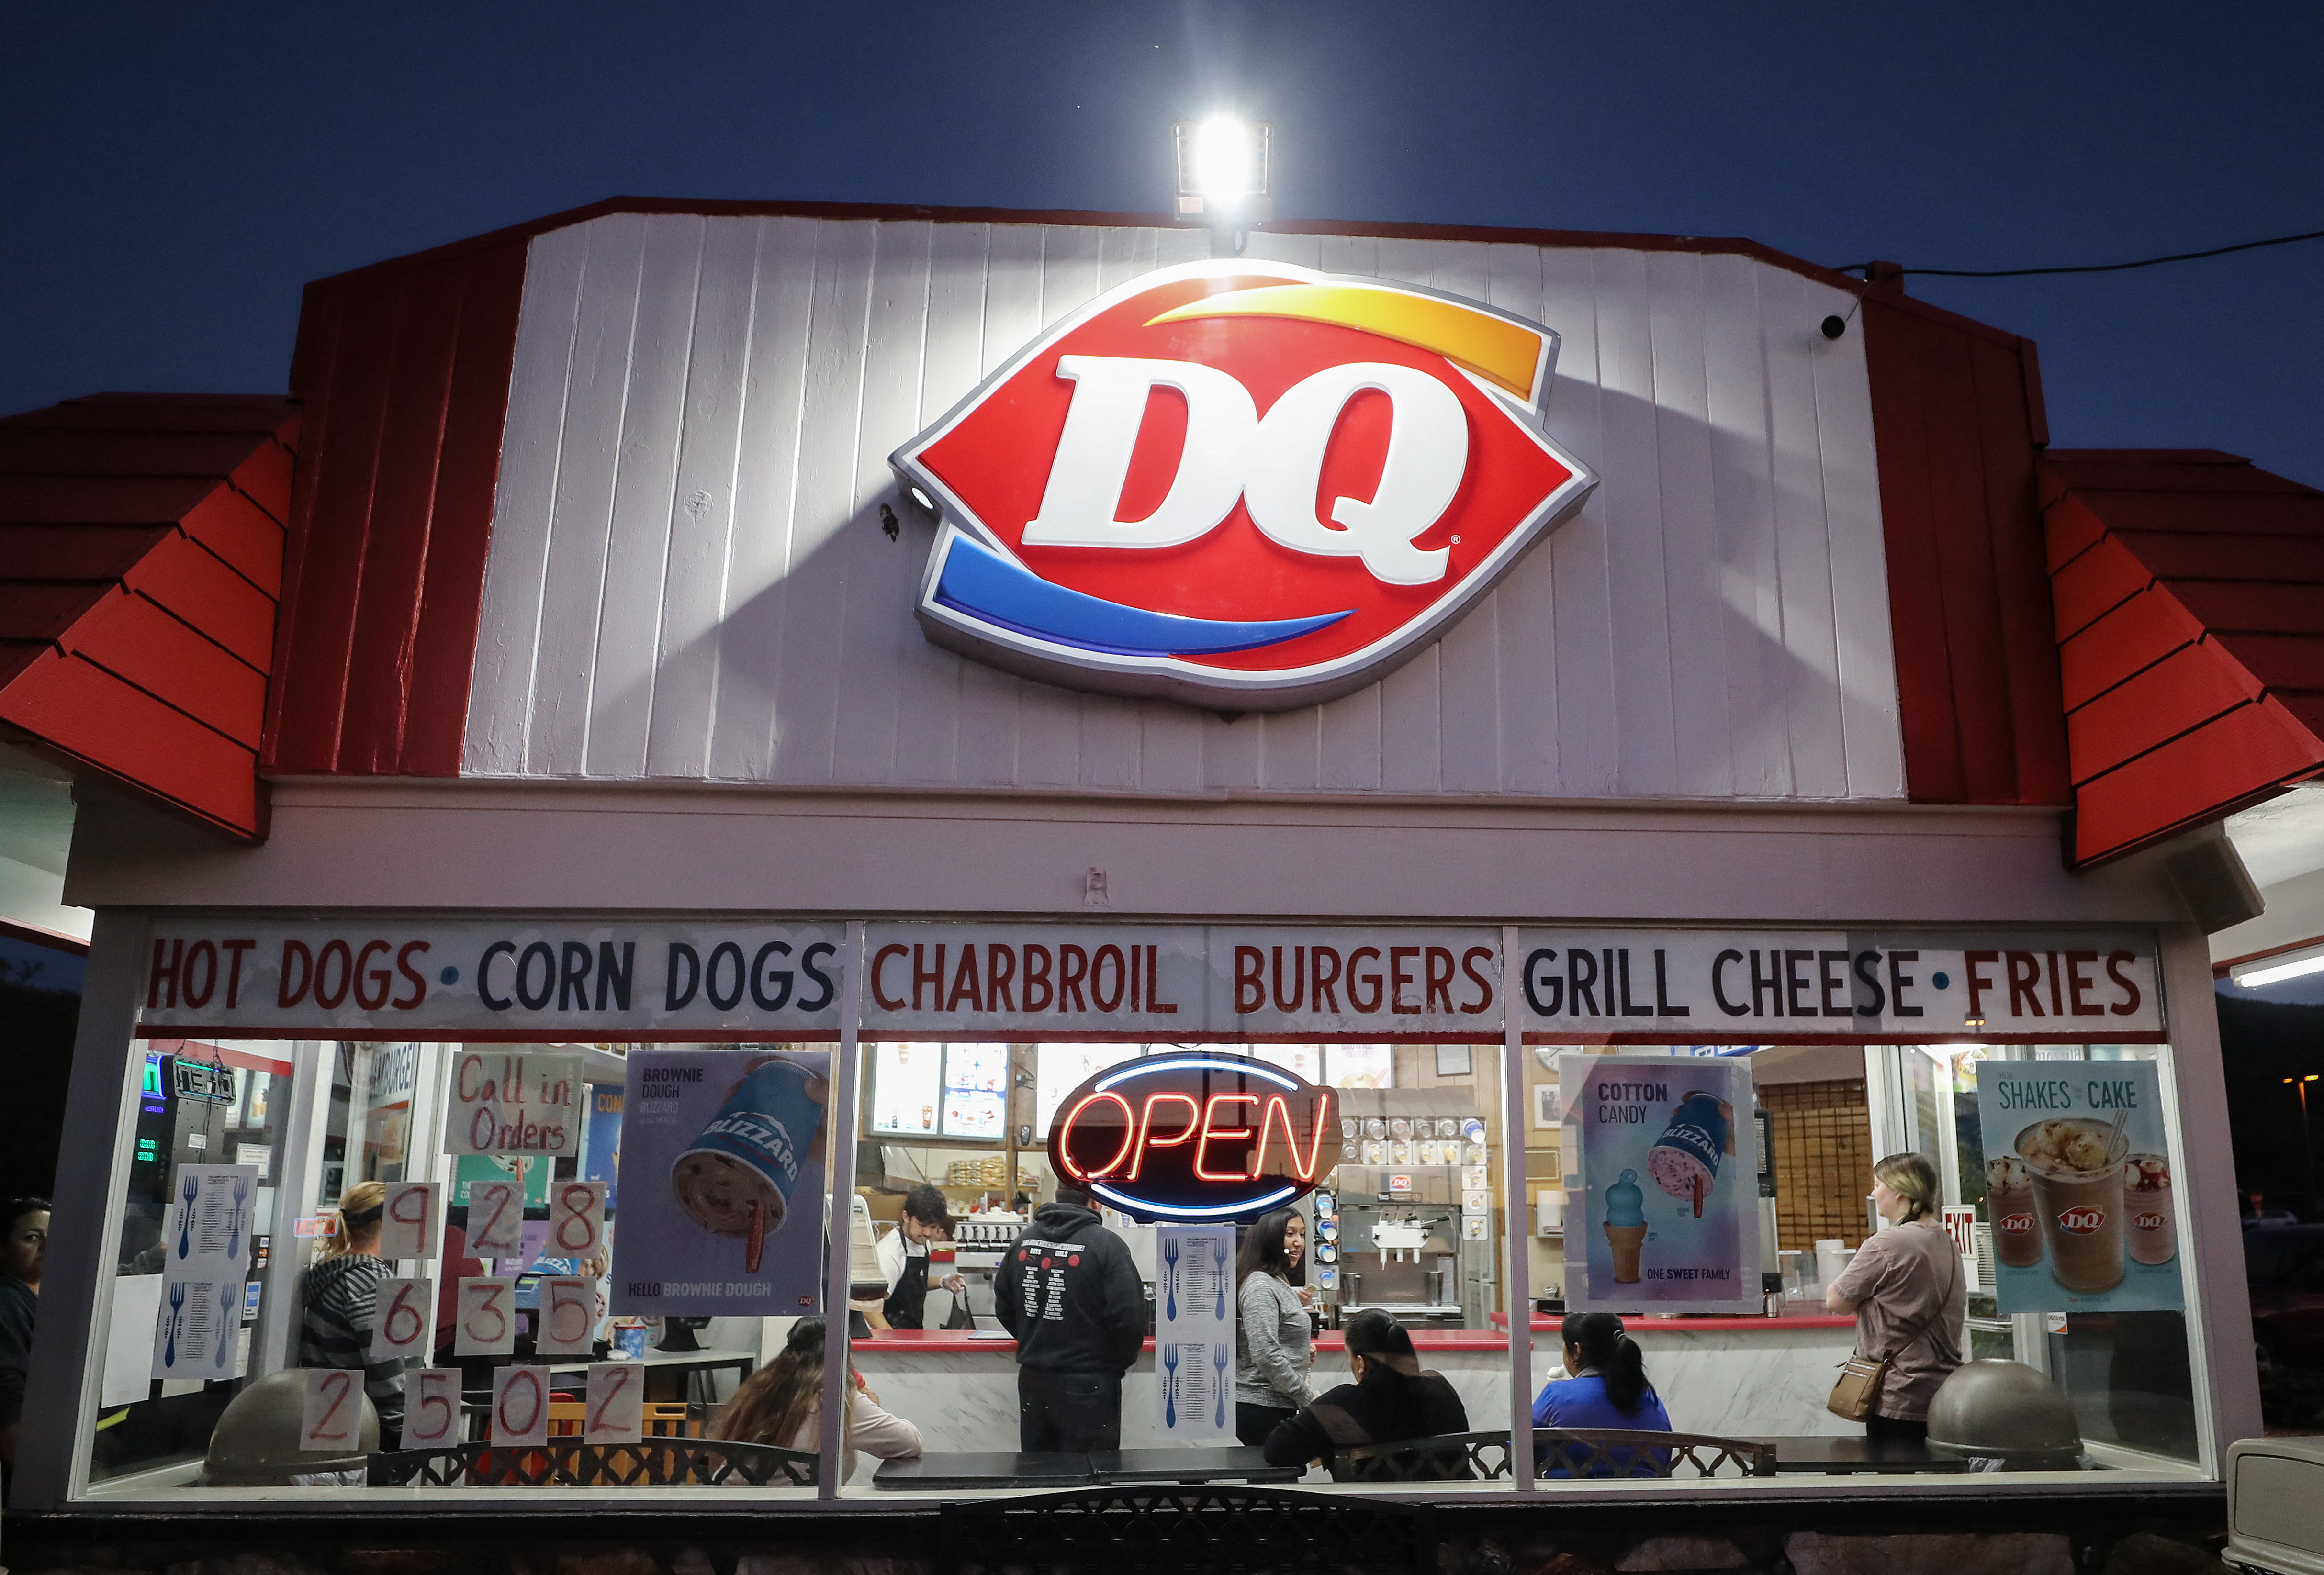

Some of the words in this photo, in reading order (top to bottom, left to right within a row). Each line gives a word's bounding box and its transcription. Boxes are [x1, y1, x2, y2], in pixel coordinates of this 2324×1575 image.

[1021, 354, 1469, 585] DQ
[147, 938, 256, 1009] HOT
[278, 939, 431, 1011] DOGS
[478, 941, 635, 1011] CORN
[664, 941, 837, 1012] DOGS
[870, 943, 1178, 1014] CHARBROIL
[1234, 945, 1494, 1015] BURGERS
[1523, 948, 1690, 1016] GRILL
[1712, 949, 1924, 1017] CHEESE
[1965, 950, 2141, 1016] FRIES
[459, 1054, 525, 1103] Call
[540, 1073, 570, 1106] in
[642, 1084, 679, 1099] DOUGH
[643, 1068, 703, 1082] BROWNIE
[1598, 1083, 1667, 1101] COTTON
[1998, 1081, 2072, 1109] SHAKES
[2088, 1081, 2137, 1109] CAKE
[470, 1107, 566, 1150] Orders
[1599, 1105, 1647, 1124] CANDY
[702, 1119, 797, 1182] BLIZZARD
[1060, 1090, 1329, 1181] OPEN
[1661, 1128, 1718, 1166] BLIZZARD
[390, 1186, 429, 1252] 9
[472, 1185, 512, 1249] 2
[556, 1185, 595, 1250] 8
[2006, 1218, 2030, 1230] DQ
[2068, 1213, 2099, 1228] DQ
[2139, 1216, 2160, 1227] DQ
[629, 1283, 660, 1296] HELLO
[663, 1283, 723, 1296] BROWNIE
[725, 1283, 772, 1296] DOUGH
[1647, 1269, 1664, 1279] ONE
[1667, 1269, 1699, 1279] SWEET
[1702, 1269, 1731, 1279] FAMILY
[384, 1284, 422, 1345] 6
[464, 1285, 505, 1343] 3
[550, 1281, 589, 1343] 5
[310, 1372, 350, 1440] 2
[413, 1374, 452, 1439] 5
[499, 1370, 541, 1436] 0
[590, 1367, 632, 1433] 2
